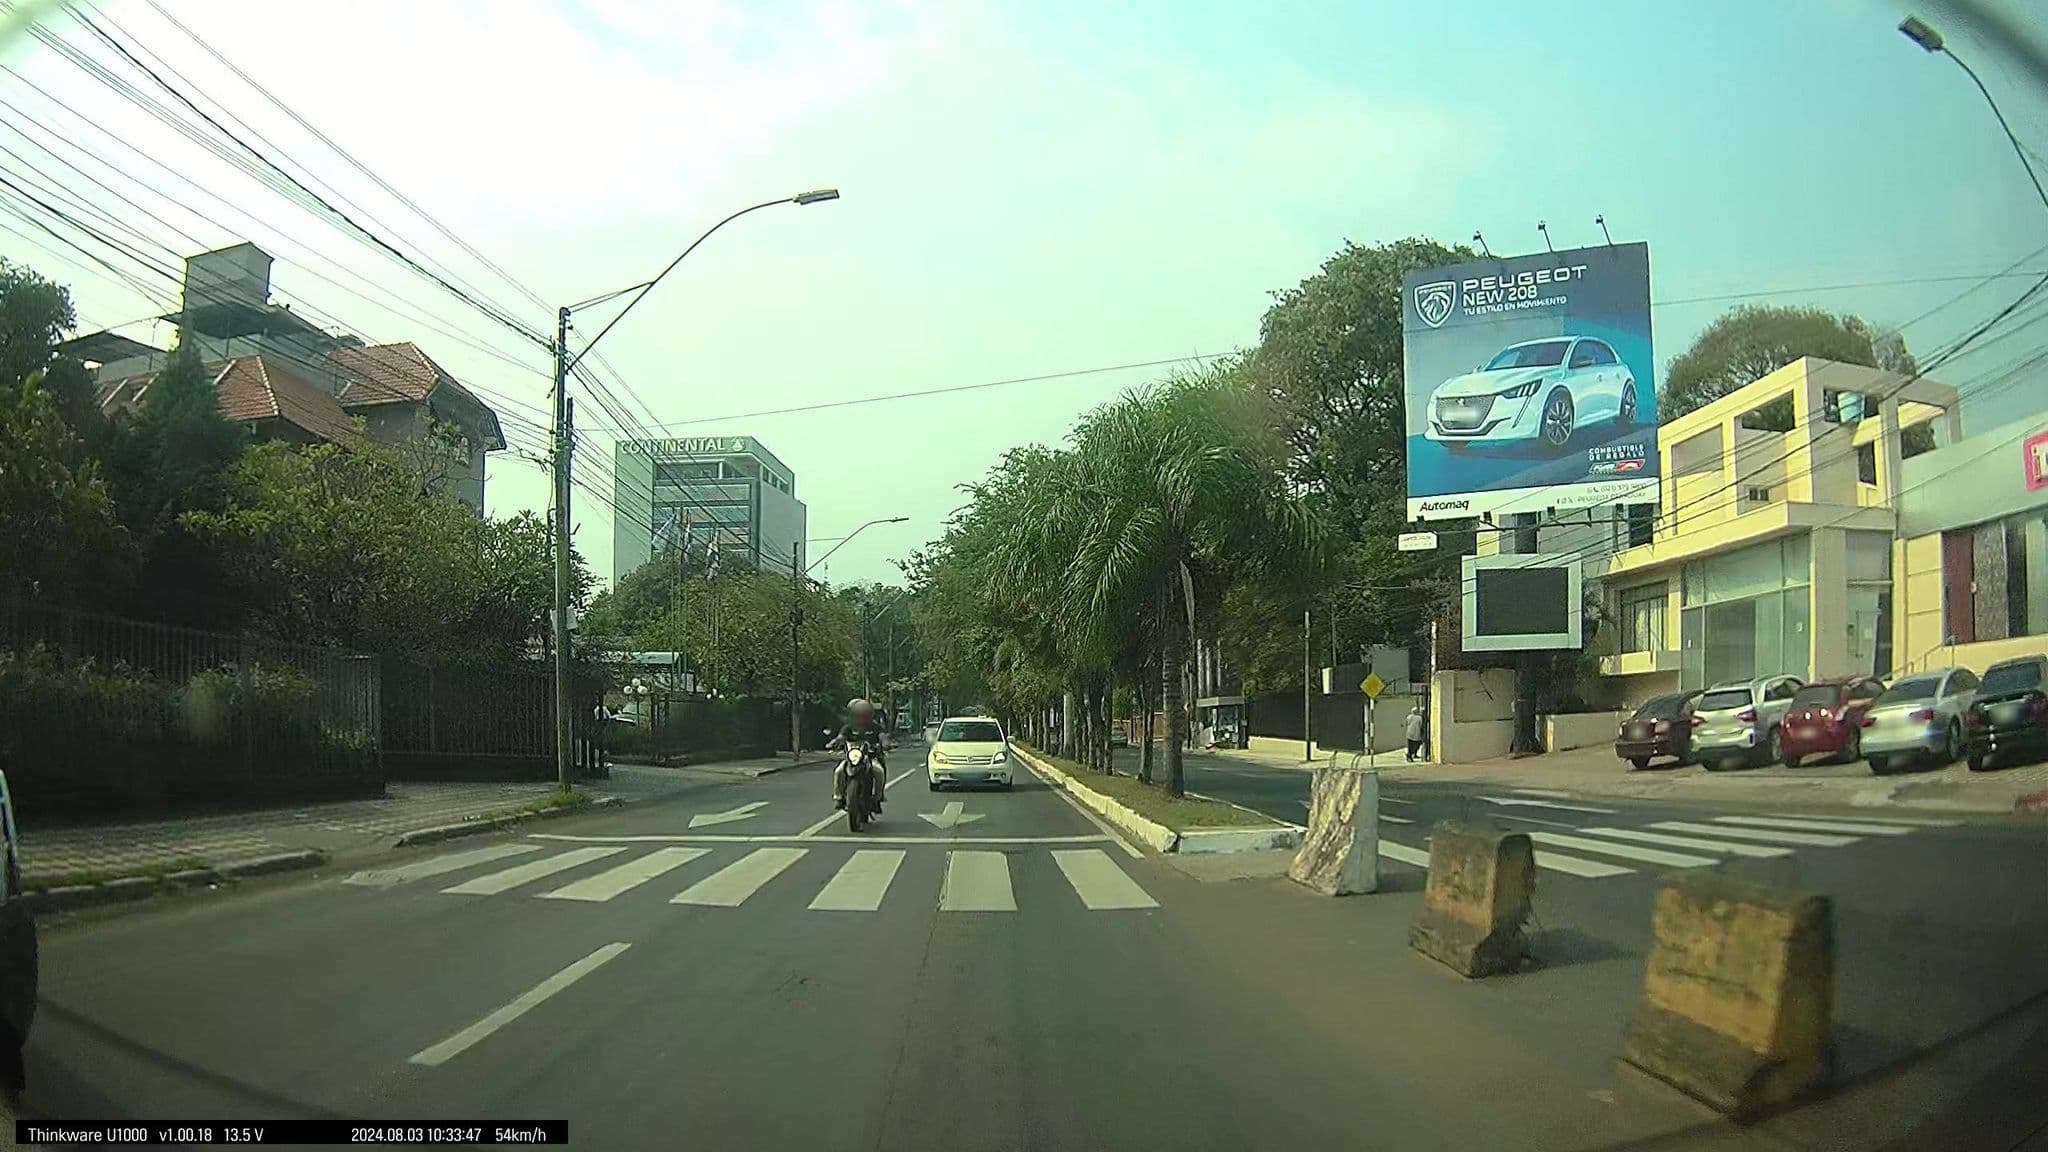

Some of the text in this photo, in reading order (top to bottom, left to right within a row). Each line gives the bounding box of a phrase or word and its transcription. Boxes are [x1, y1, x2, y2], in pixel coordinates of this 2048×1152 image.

[1463, 265, 1587, 291] PEUGEOT
[1463, 289, 1503, 306] NEW
[1508, 285, 1538, 301] 208
[1464, 295, 1568, 316] TU ESTILO EN MOVIMIENTO
[621, 438, 726, 454] CONTINENTAL
[1589, 444, 1644, 454] COMBUSTIBLE
[1419, 500, 1469, 512] Automaq
